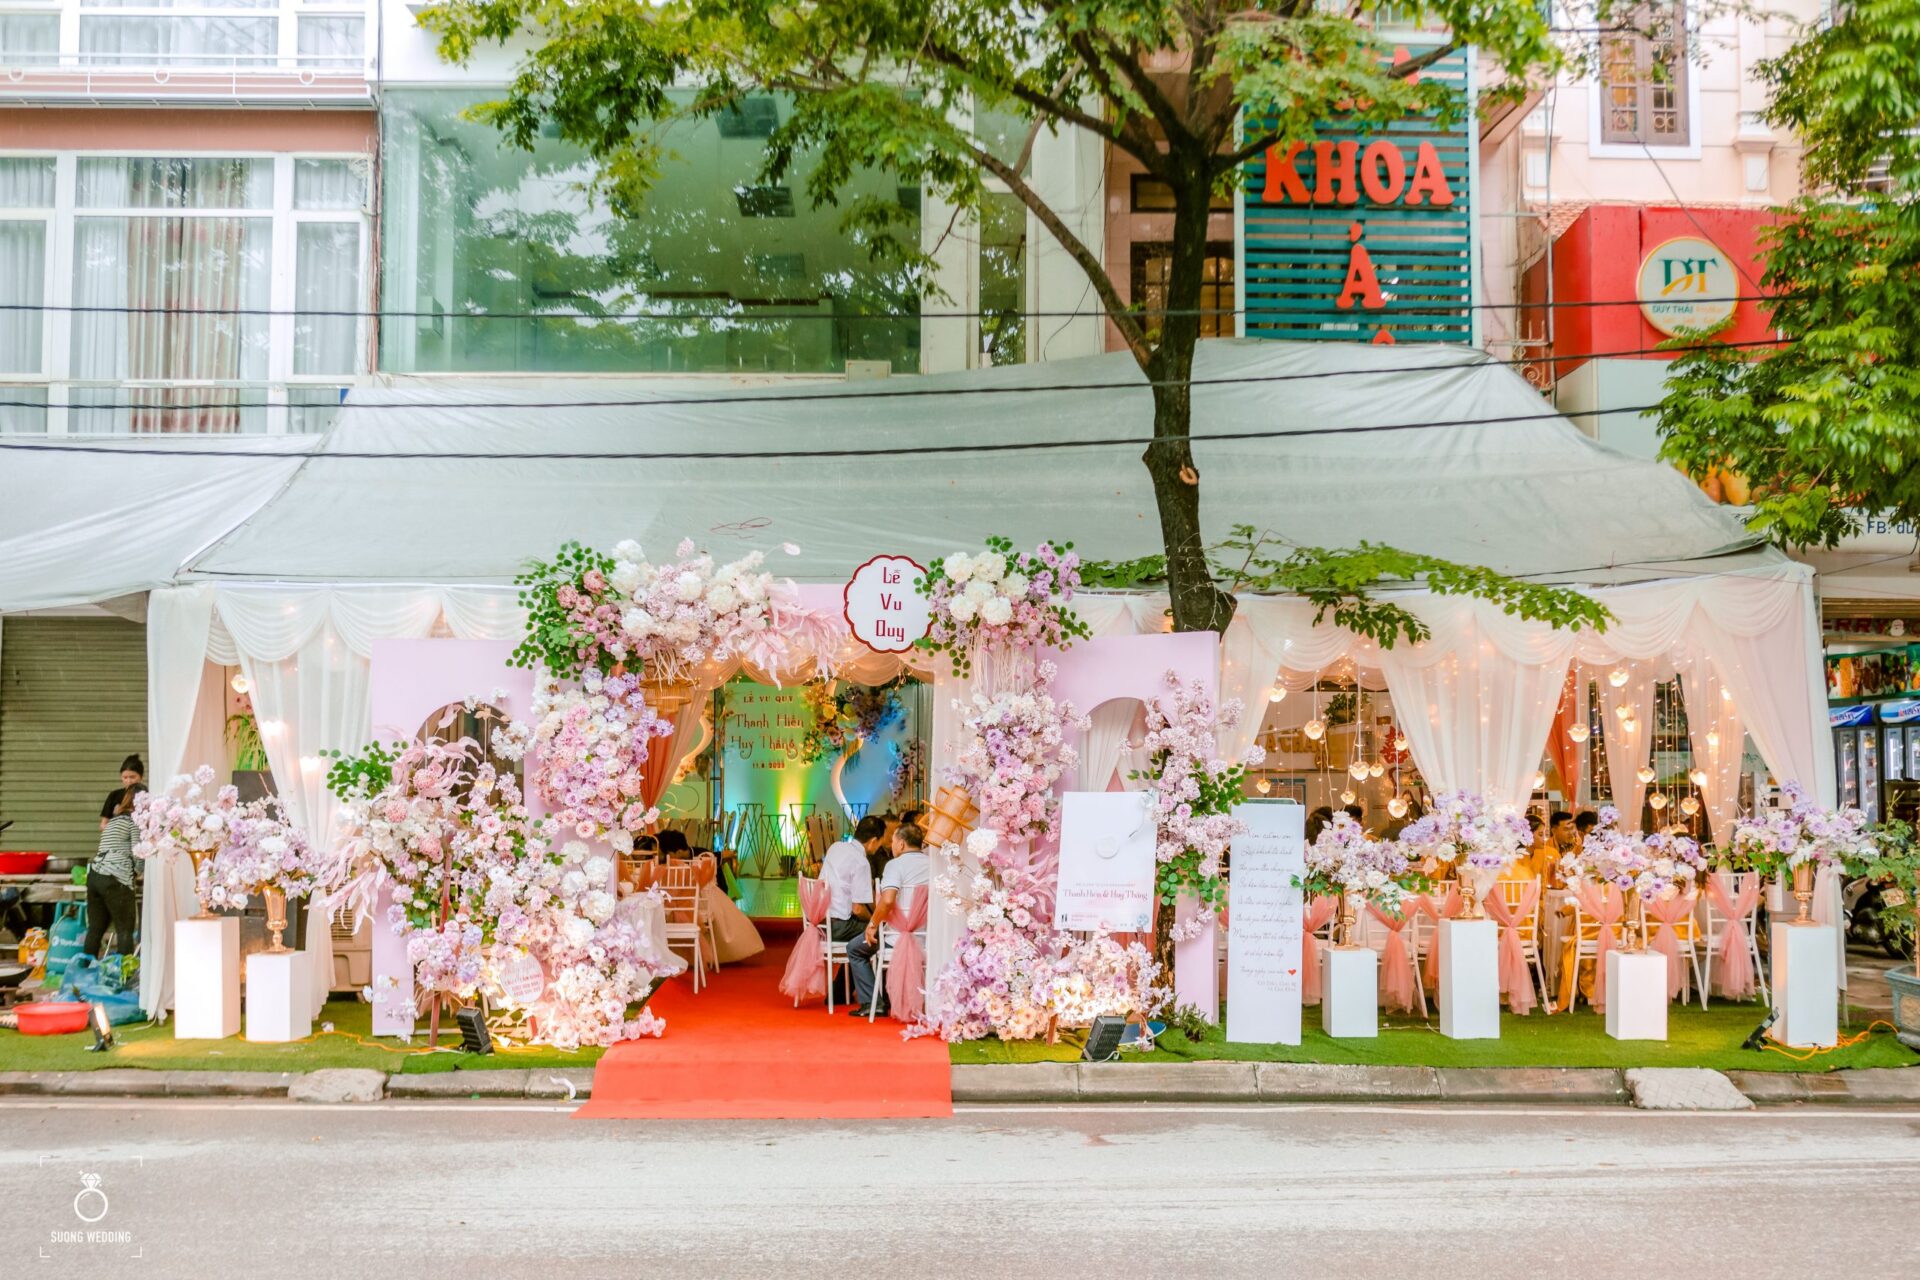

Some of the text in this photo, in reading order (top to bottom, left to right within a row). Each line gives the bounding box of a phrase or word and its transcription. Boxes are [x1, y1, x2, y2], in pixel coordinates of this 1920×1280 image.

[1261, 139, 1455, 206] KHOA
[1335, 222, 1387, 309] Á
[1652, 304, 1671, 314] DUY
[1867, 520, 1891, 534] FB:
[880, 593, 902, 611] Vu
[875, 619, 905, 642] Quy
[775, 695, 794, 703] QUY
[735, 713, 769, 729] Thanh
